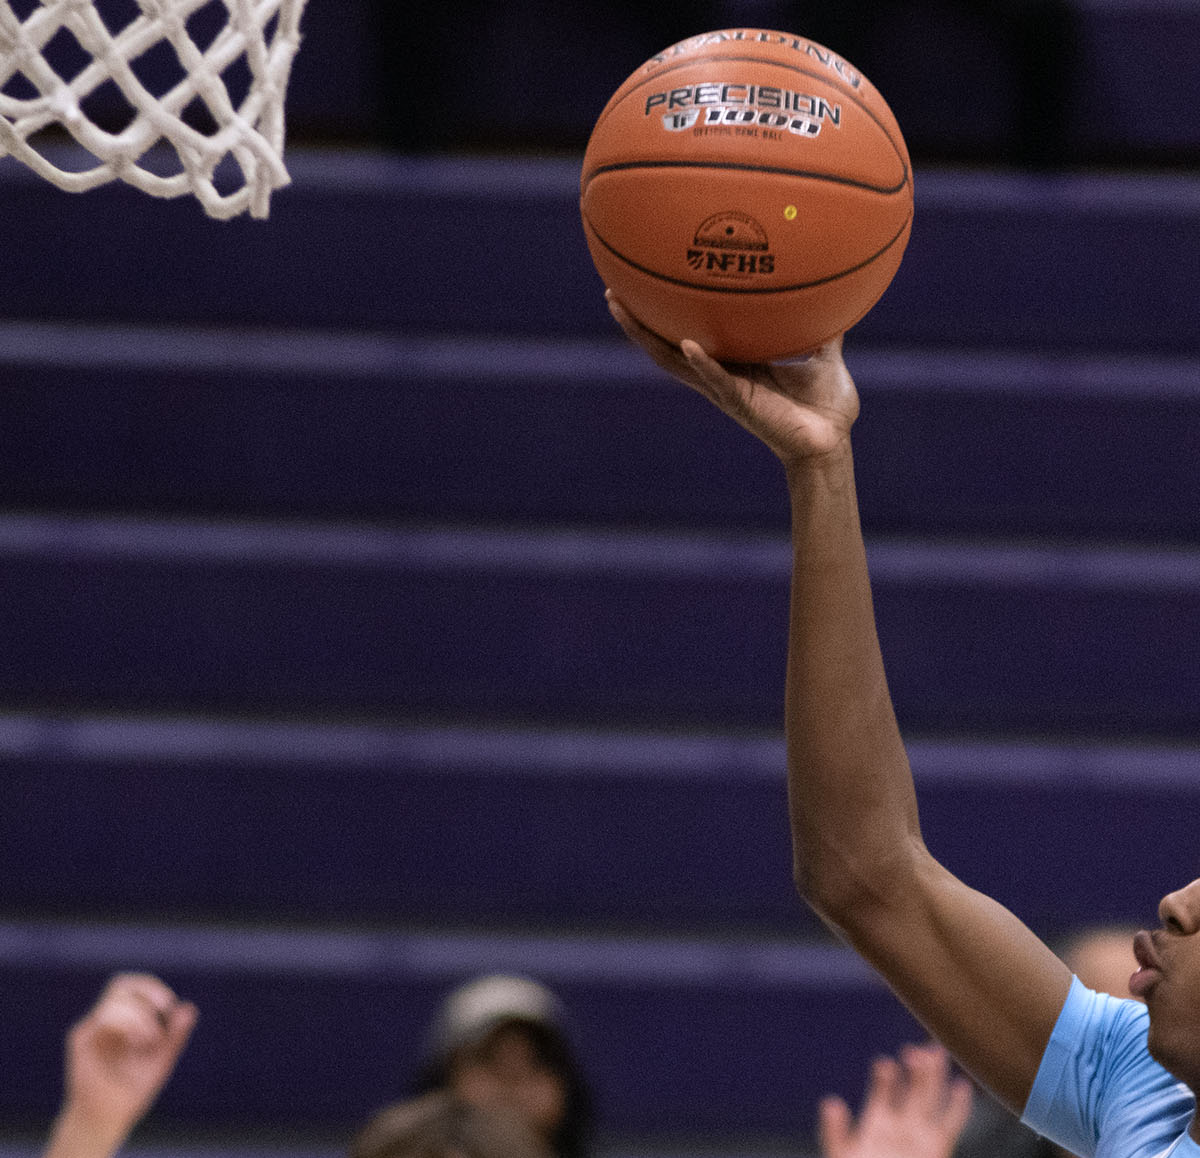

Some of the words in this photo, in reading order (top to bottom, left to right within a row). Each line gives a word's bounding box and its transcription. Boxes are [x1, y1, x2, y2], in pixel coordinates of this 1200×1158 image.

[645, 84, 841, 128] PRECISION
[705, 107, 822, 138] 1000
[705, 251, 775, 274] NFHS
